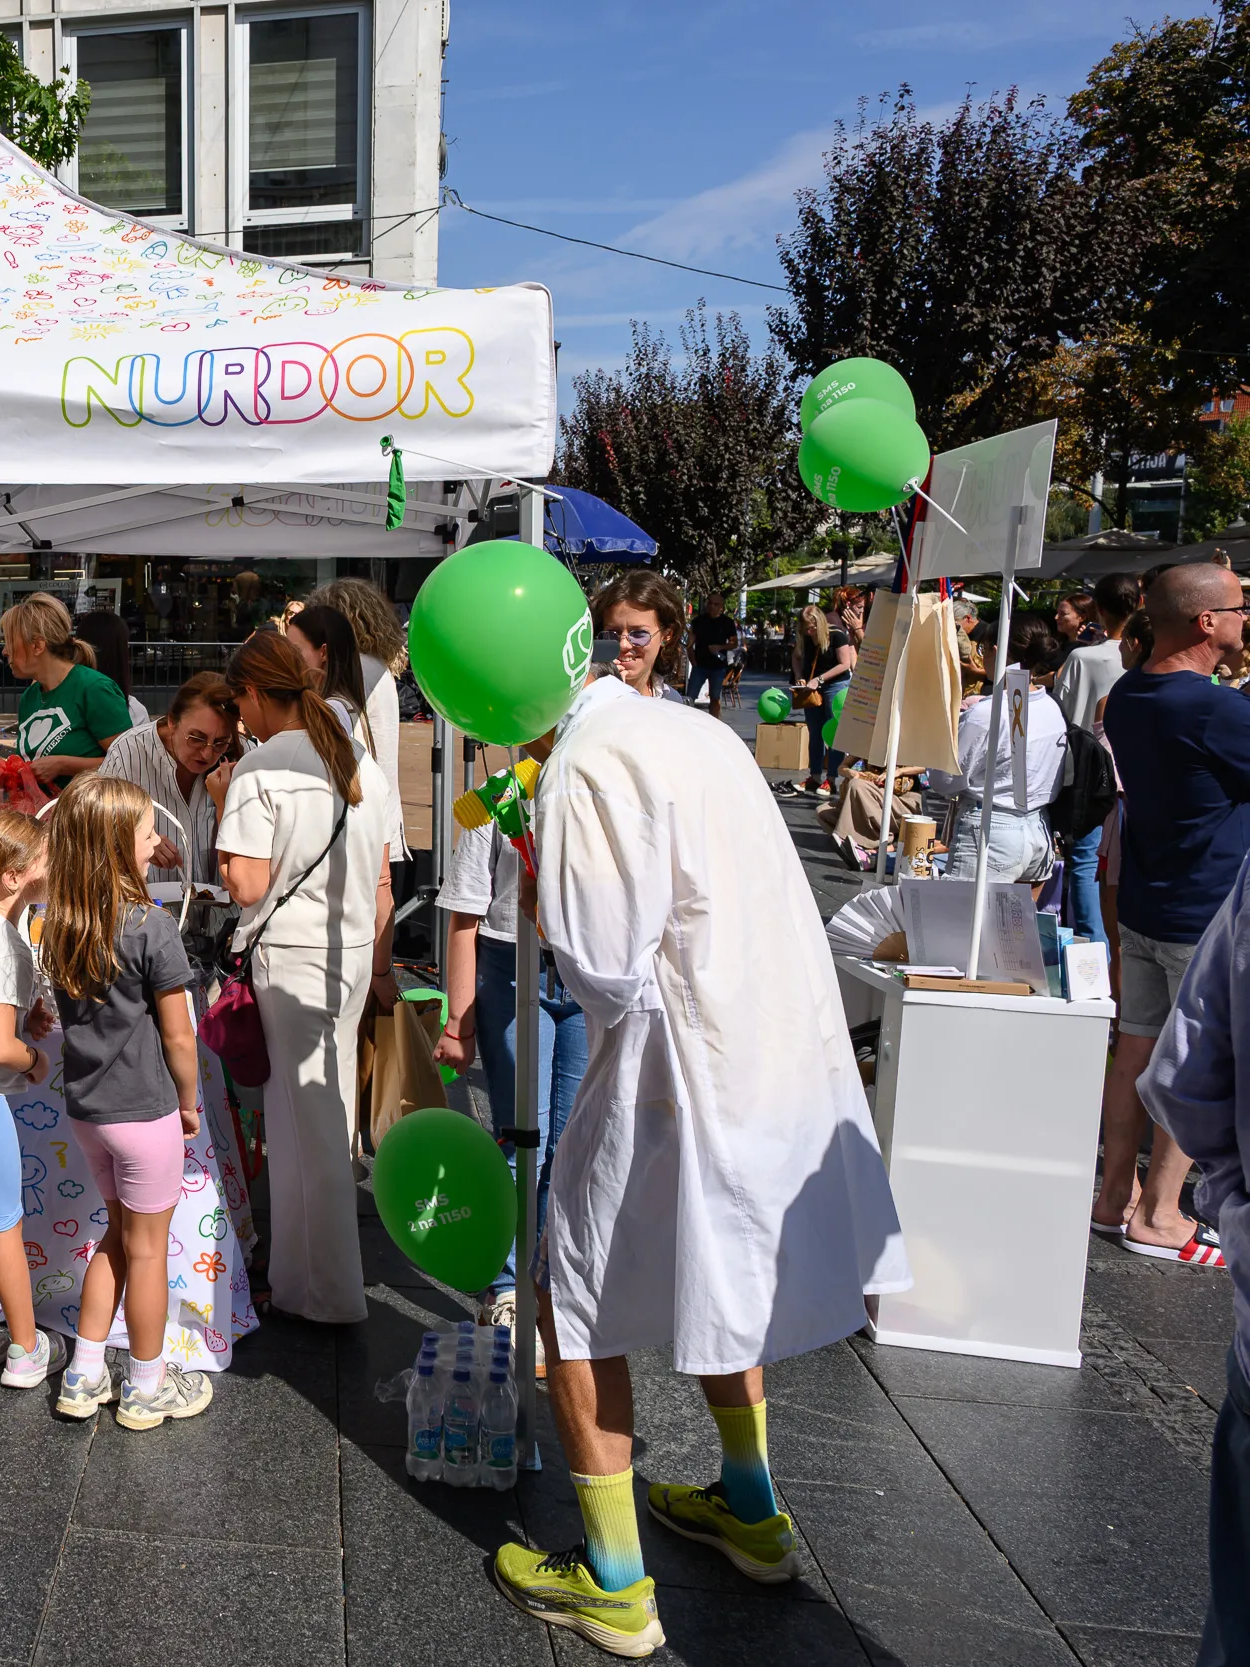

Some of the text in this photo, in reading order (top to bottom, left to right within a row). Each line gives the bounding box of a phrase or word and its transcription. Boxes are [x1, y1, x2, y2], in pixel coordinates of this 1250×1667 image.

[61, 327, 475, 428] NURDOR
[817, 380, 839, 401] SMS
[831, 381, 856, 399] 1150
[826, 466, 841, 491] 1150
[415, 1193, 449, 1212] SMS
[407, 1206, 472, 1232] 2 na 1150
